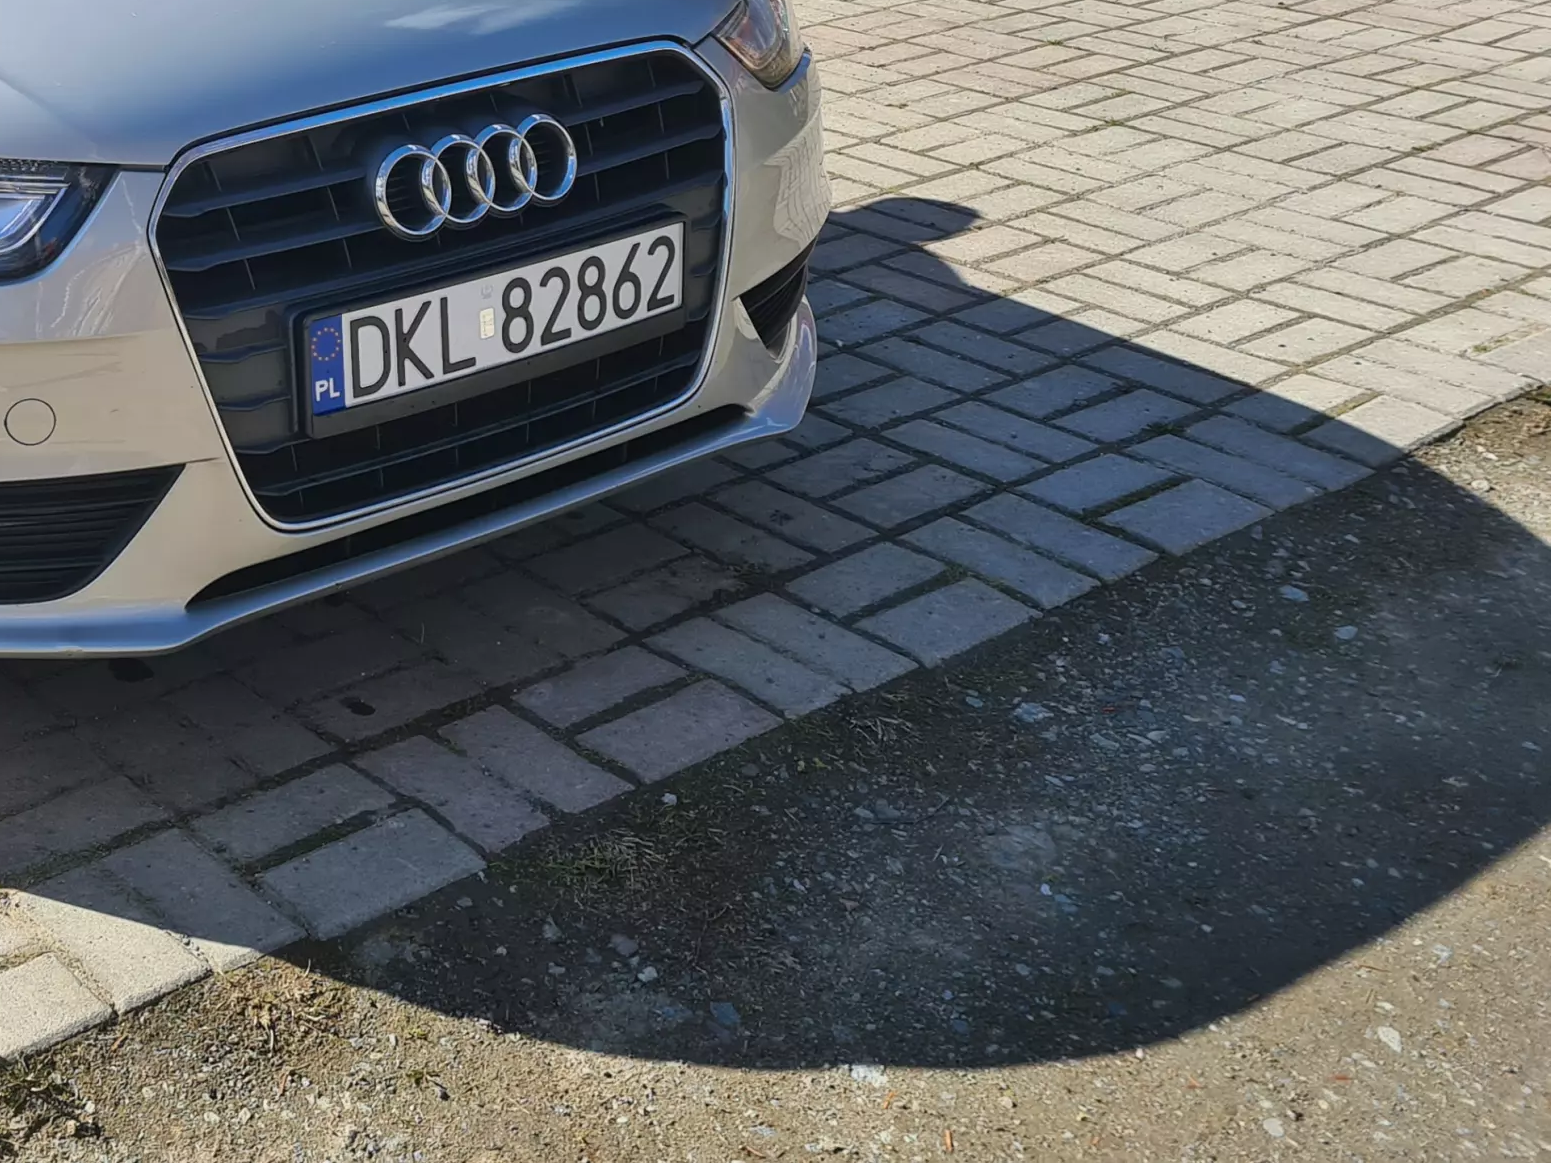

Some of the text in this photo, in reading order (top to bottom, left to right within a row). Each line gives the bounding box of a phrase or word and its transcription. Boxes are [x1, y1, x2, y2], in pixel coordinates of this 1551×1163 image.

[349, 235, 676, 399] DKL 82862
[314, 377, 341, 402] PL
